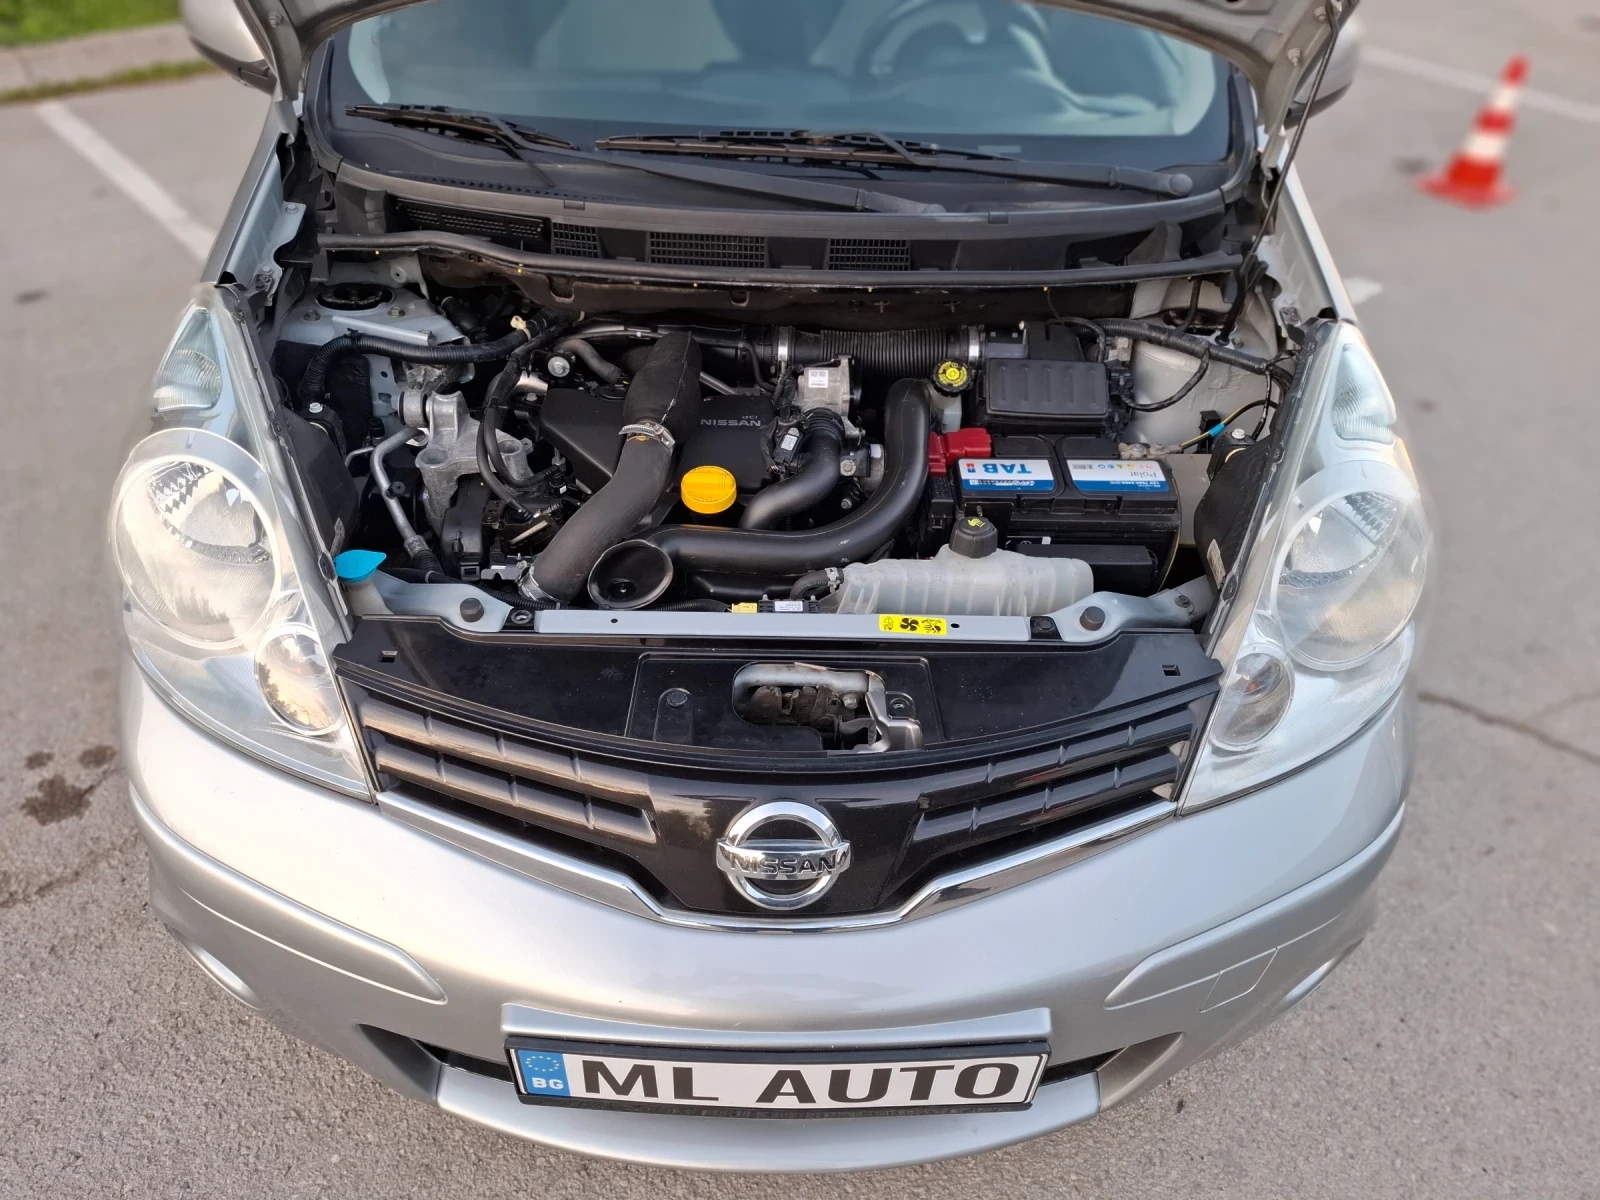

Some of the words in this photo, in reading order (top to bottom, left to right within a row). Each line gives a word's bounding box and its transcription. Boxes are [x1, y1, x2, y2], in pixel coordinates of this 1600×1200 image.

[700, 418, 761, 427] NISSAN
[982, 463, 1032, 474] TAB
[730, 854, 837, 875] NISSAN
[532, 1077, 564, 1089] BG
[582, 1060, 719, 1101] ML
[755, 1063, 1020, 1103] AUTO
